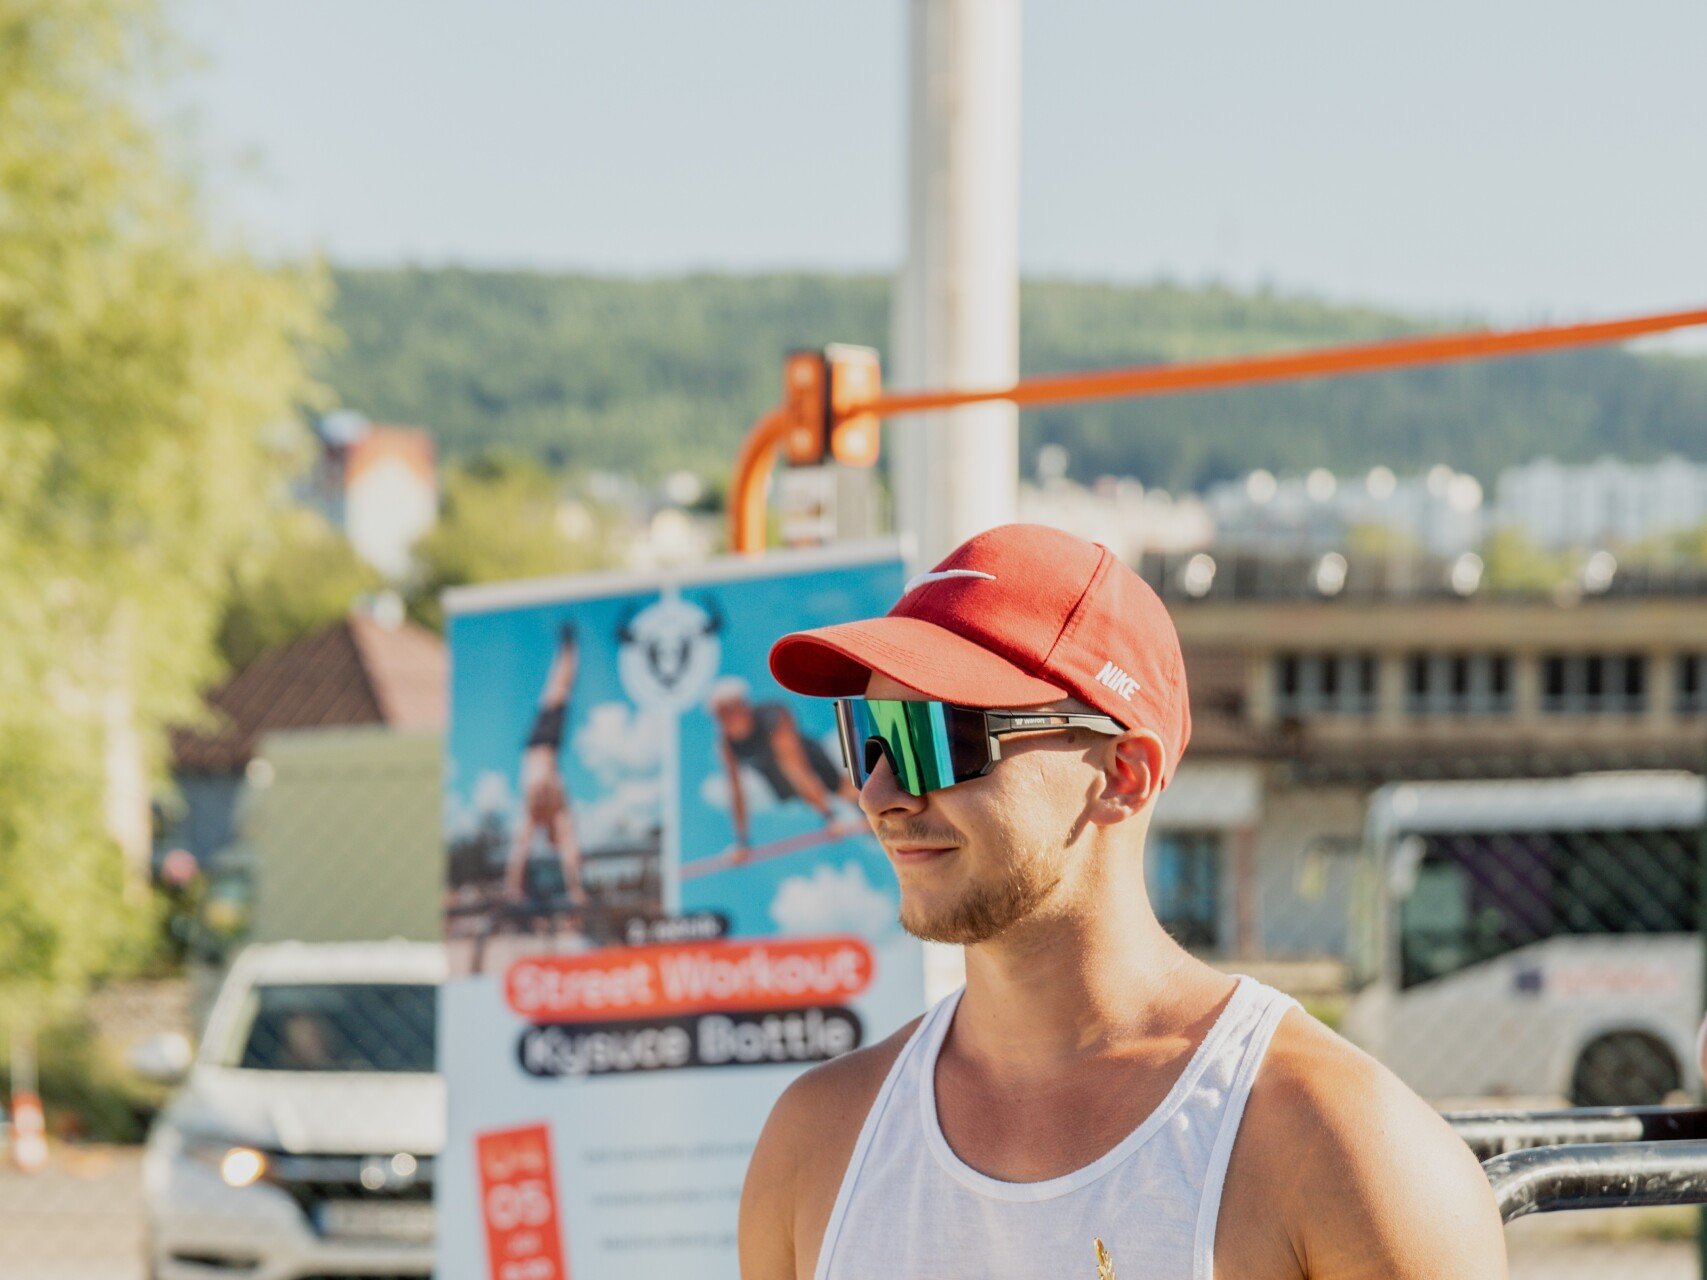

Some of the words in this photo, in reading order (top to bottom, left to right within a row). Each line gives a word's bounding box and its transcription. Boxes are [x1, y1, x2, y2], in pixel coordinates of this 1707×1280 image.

[1094, 660, 1140, 701] NIKE
[514, 962, 653, 1011] Street
[661, 949, 860, 1000] Workout
[526, 1025, 691, 1077] Kysuce
[699, 1012, 855, 1062] Battle
